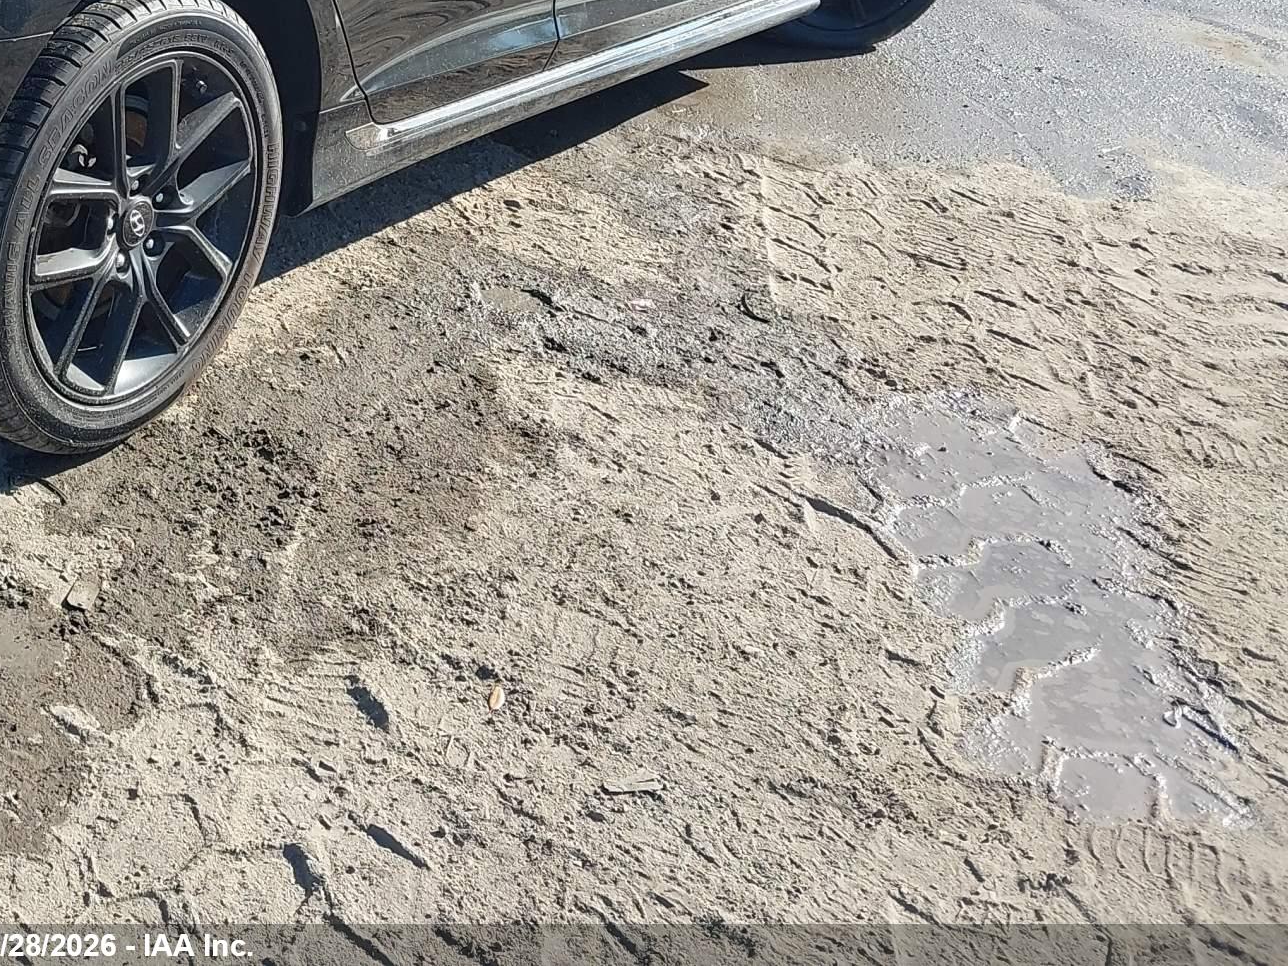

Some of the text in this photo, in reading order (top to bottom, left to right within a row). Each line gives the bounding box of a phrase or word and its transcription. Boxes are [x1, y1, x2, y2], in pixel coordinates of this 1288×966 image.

[15, 175, 41, 234] ALL
[38, 59, 112, 170] SEASON
[252, 143, 279, 265] HIGHWAY
[192, 272, 254, 378] TOURING
